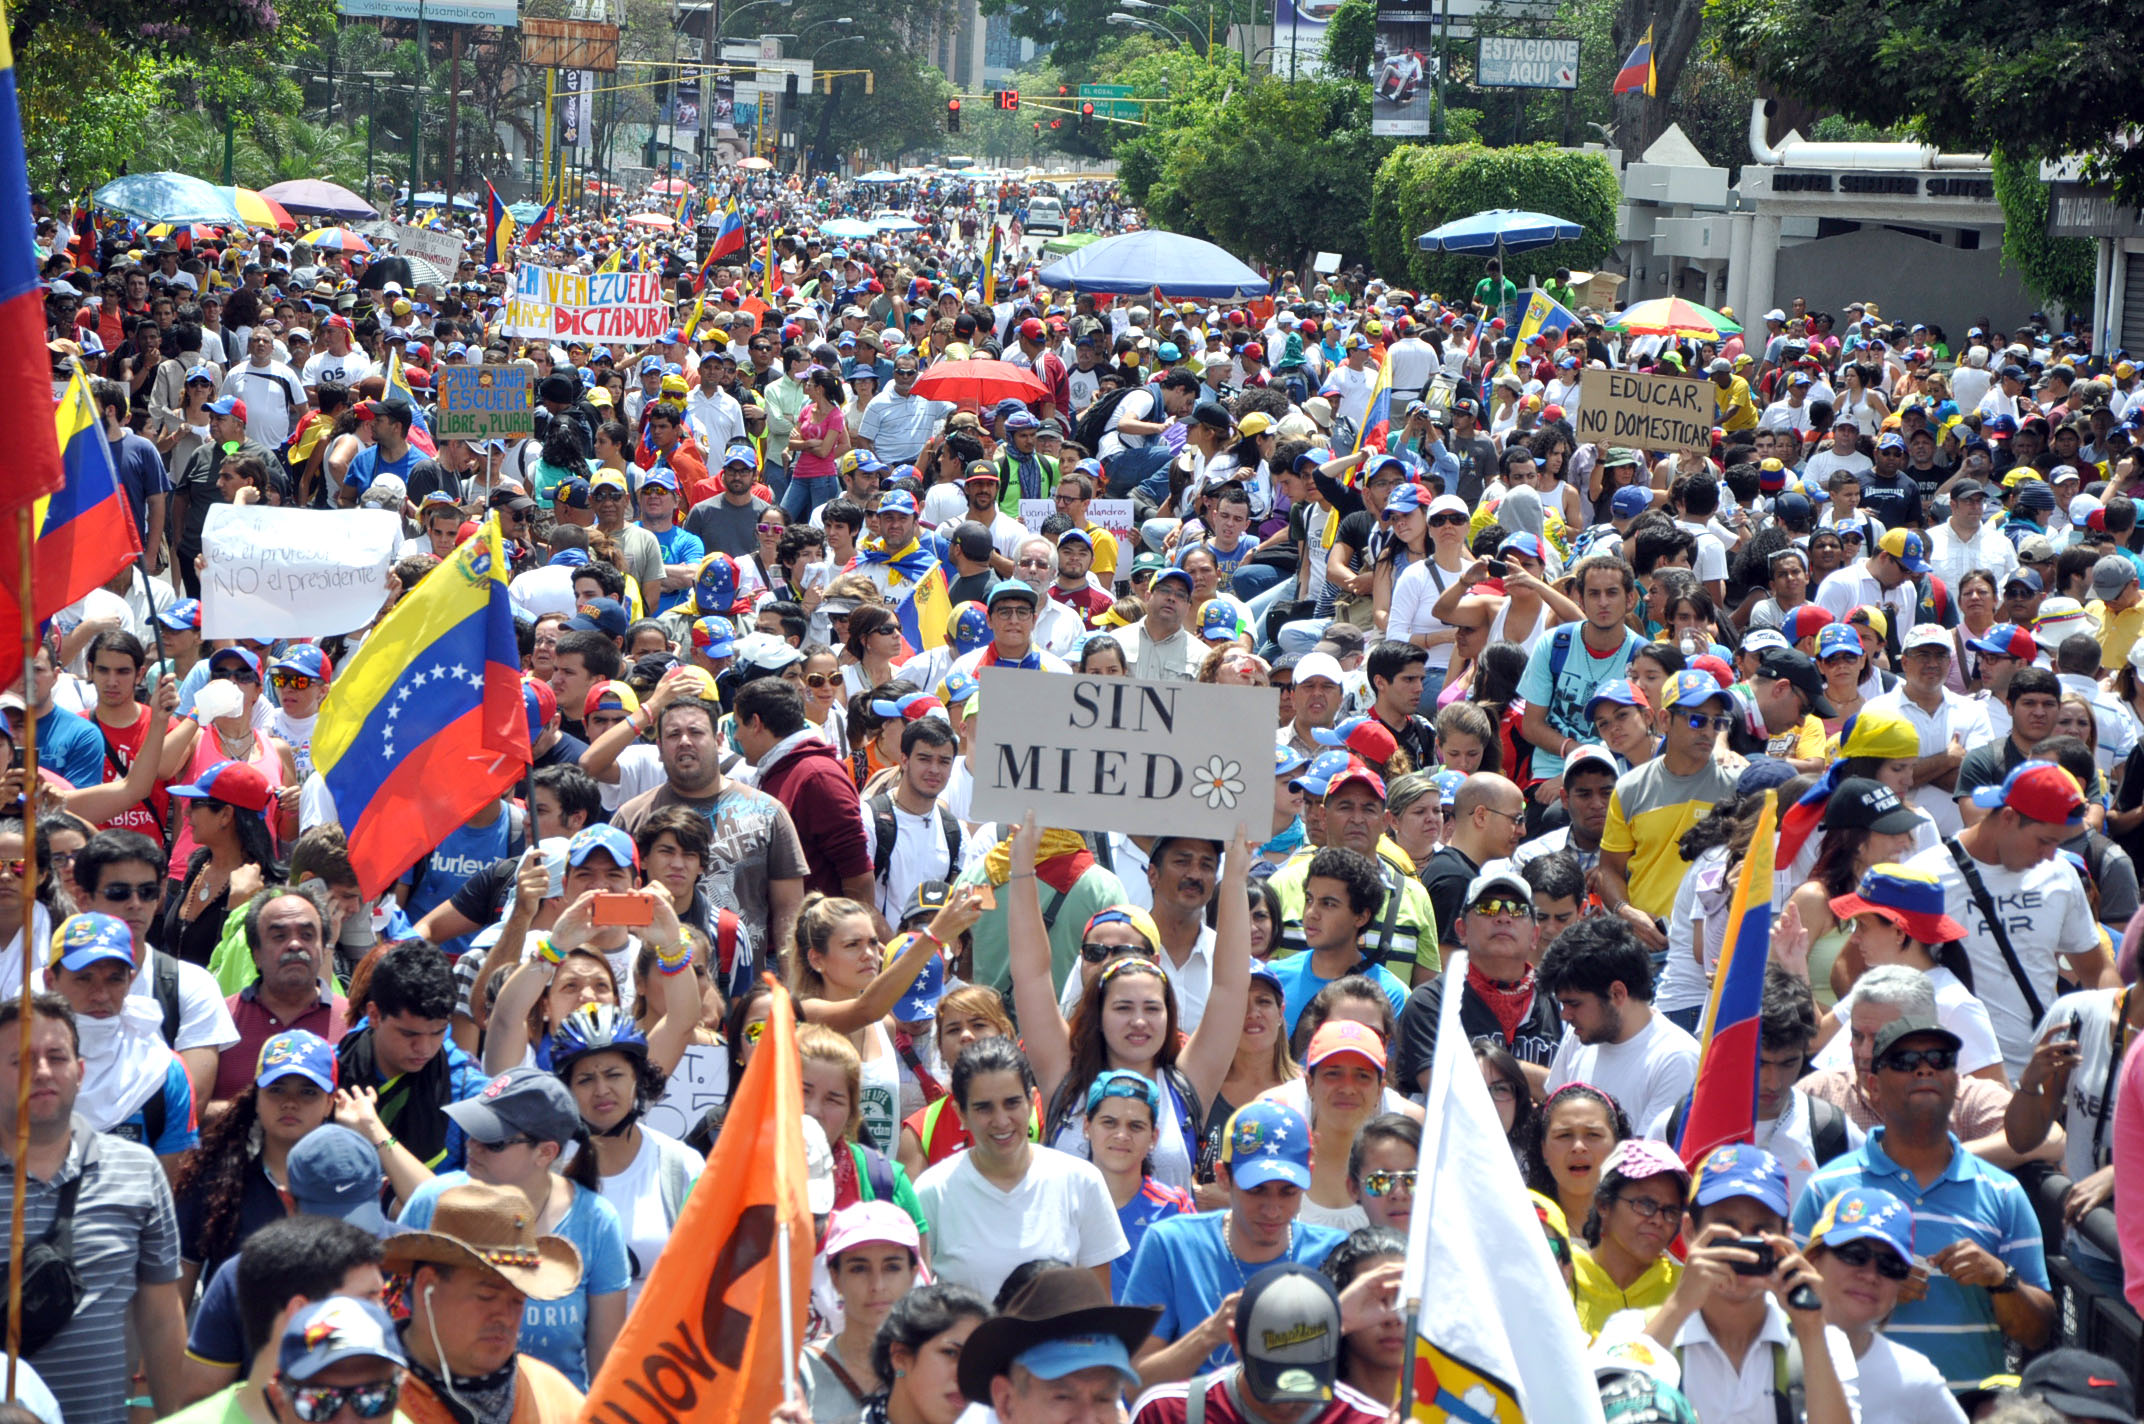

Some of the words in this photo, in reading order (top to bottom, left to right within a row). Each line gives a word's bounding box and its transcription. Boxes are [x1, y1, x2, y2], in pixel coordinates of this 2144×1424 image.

[364, 1, 391, 12] visita:
[394, 4, 496, 20] wwwtusambil.com
[1481, 37, 1577, 63] ESTACIONE
[1508, 62, 1551, 84] AQUI
[1001, 90, 1019, 110] 12
[517, 263, 539, 296] EN
[547, 271, 660, 306] VENEZUELA
[505, 301, 550, 328] HAY
[447, 367, 479, 389] POR
[492, 367, 526, 389] UNA
[448, 388, 527, 411] ESCUELA
[1610, 375, 1702, 413] EDUCAR,
[488, 411, 535, 433] PLURAL
[1581, 409, 1608, 433] NO
[1614, 410, 1710, 447] DOMESTICAR
[214, 566, 260, 598] NO
[267, 568, 281, 591] el
[287, 566, 377, 601] presidente
[1069, 681, 1183, 735] SIN
[1967, 892, 2043, 915] NKE
[526, 1305, 579, 1327] DRIA
